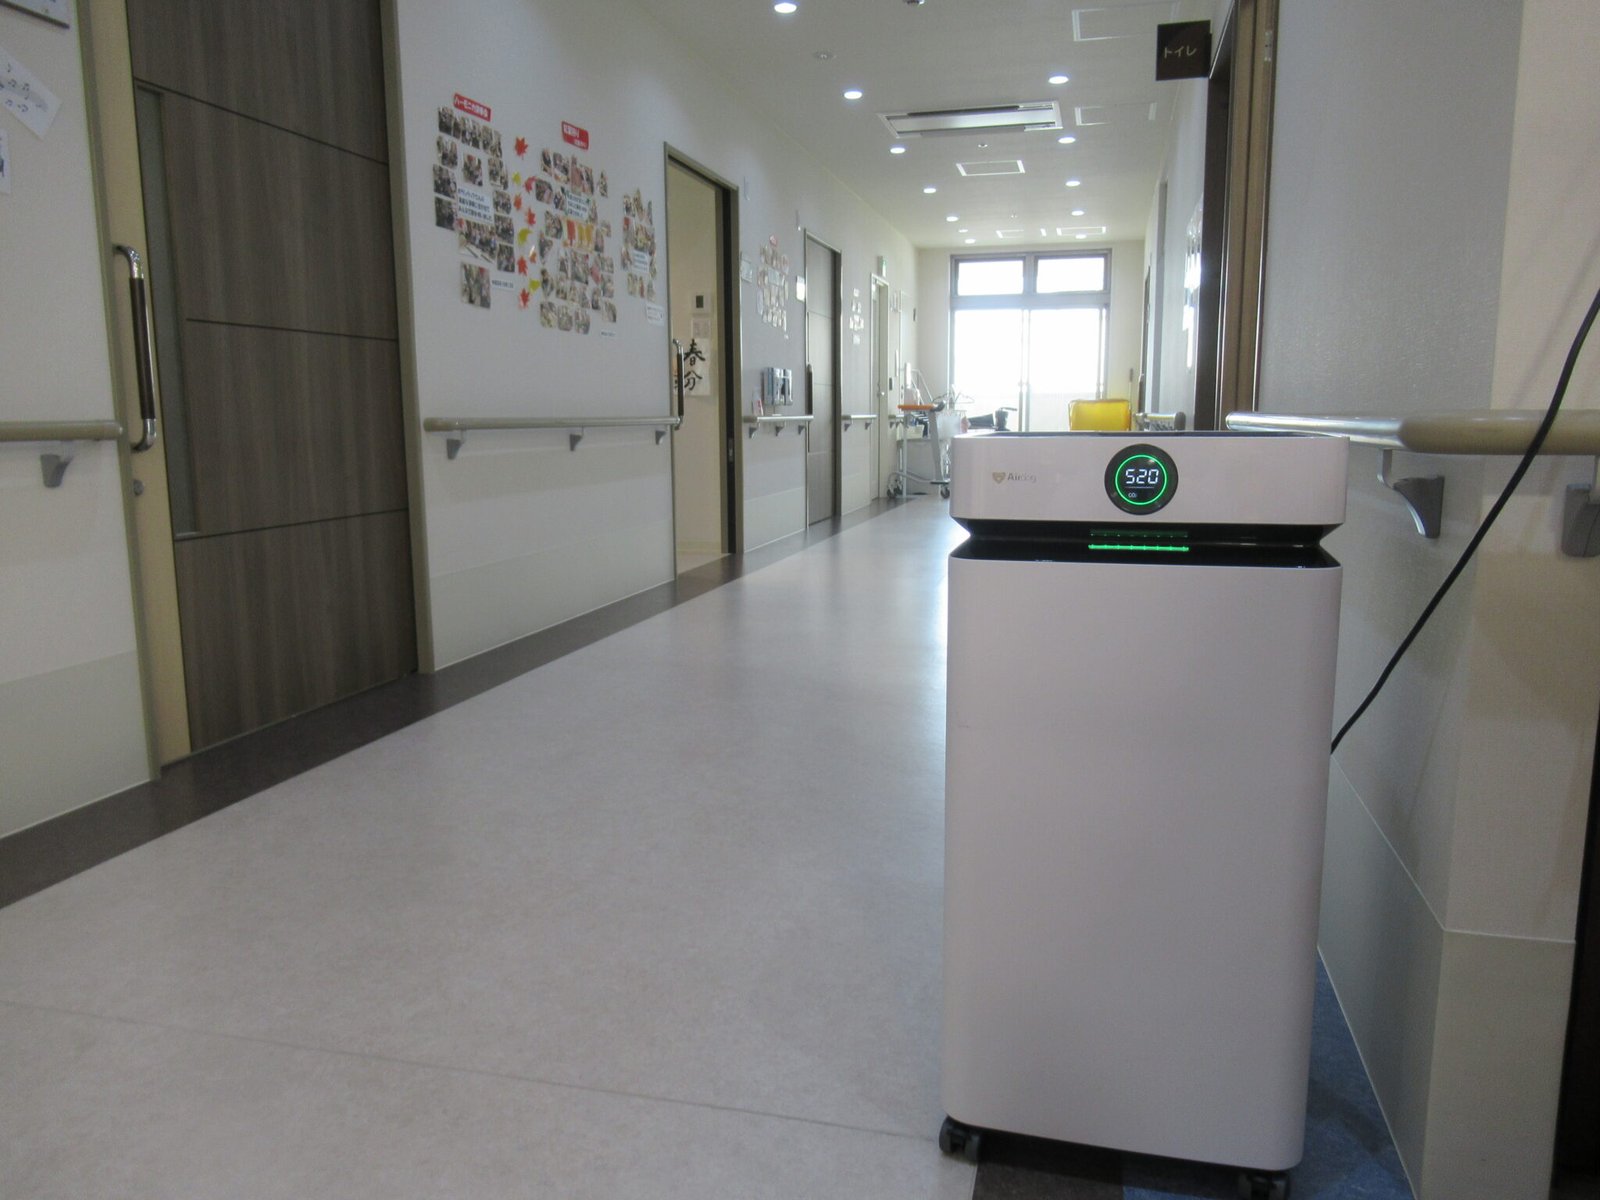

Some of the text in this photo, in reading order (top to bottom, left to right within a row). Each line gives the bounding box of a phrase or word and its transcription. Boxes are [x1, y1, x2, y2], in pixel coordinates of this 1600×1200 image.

[1164, 45, 1197, 59] トイレ
[683, 338, 706, 391] 春分
[1125, 469, 1160, 484] 520
